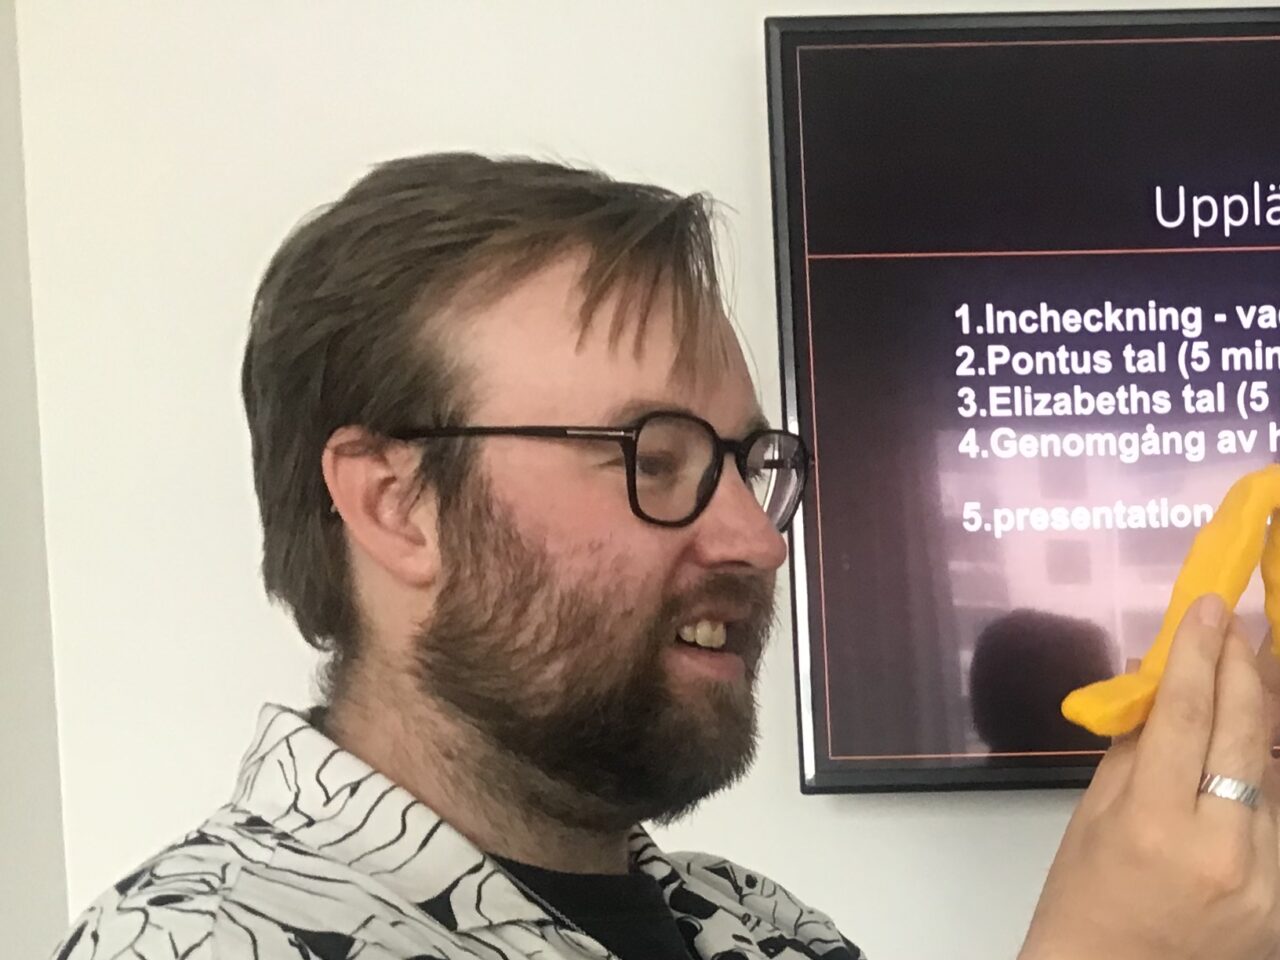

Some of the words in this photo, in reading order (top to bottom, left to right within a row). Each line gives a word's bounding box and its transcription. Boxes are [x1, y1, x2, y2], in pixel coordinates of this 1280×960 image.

[955, 300, 1203, 338] 1.Incheckning
[955, 344, 1113, 377] 2.Pontus
[1122, 341, 1167, 374] tal
[1177, 340, 1211, 380] (5
[957, 383, 1173, 418] 3.Elizabeths
[1181, 381, 1226, 414] tal
[1236, 380, 1270, 419] (5
[958, 423, 1206, 463] 4.Genomgång
[1216, 429, 1258, 454] av
